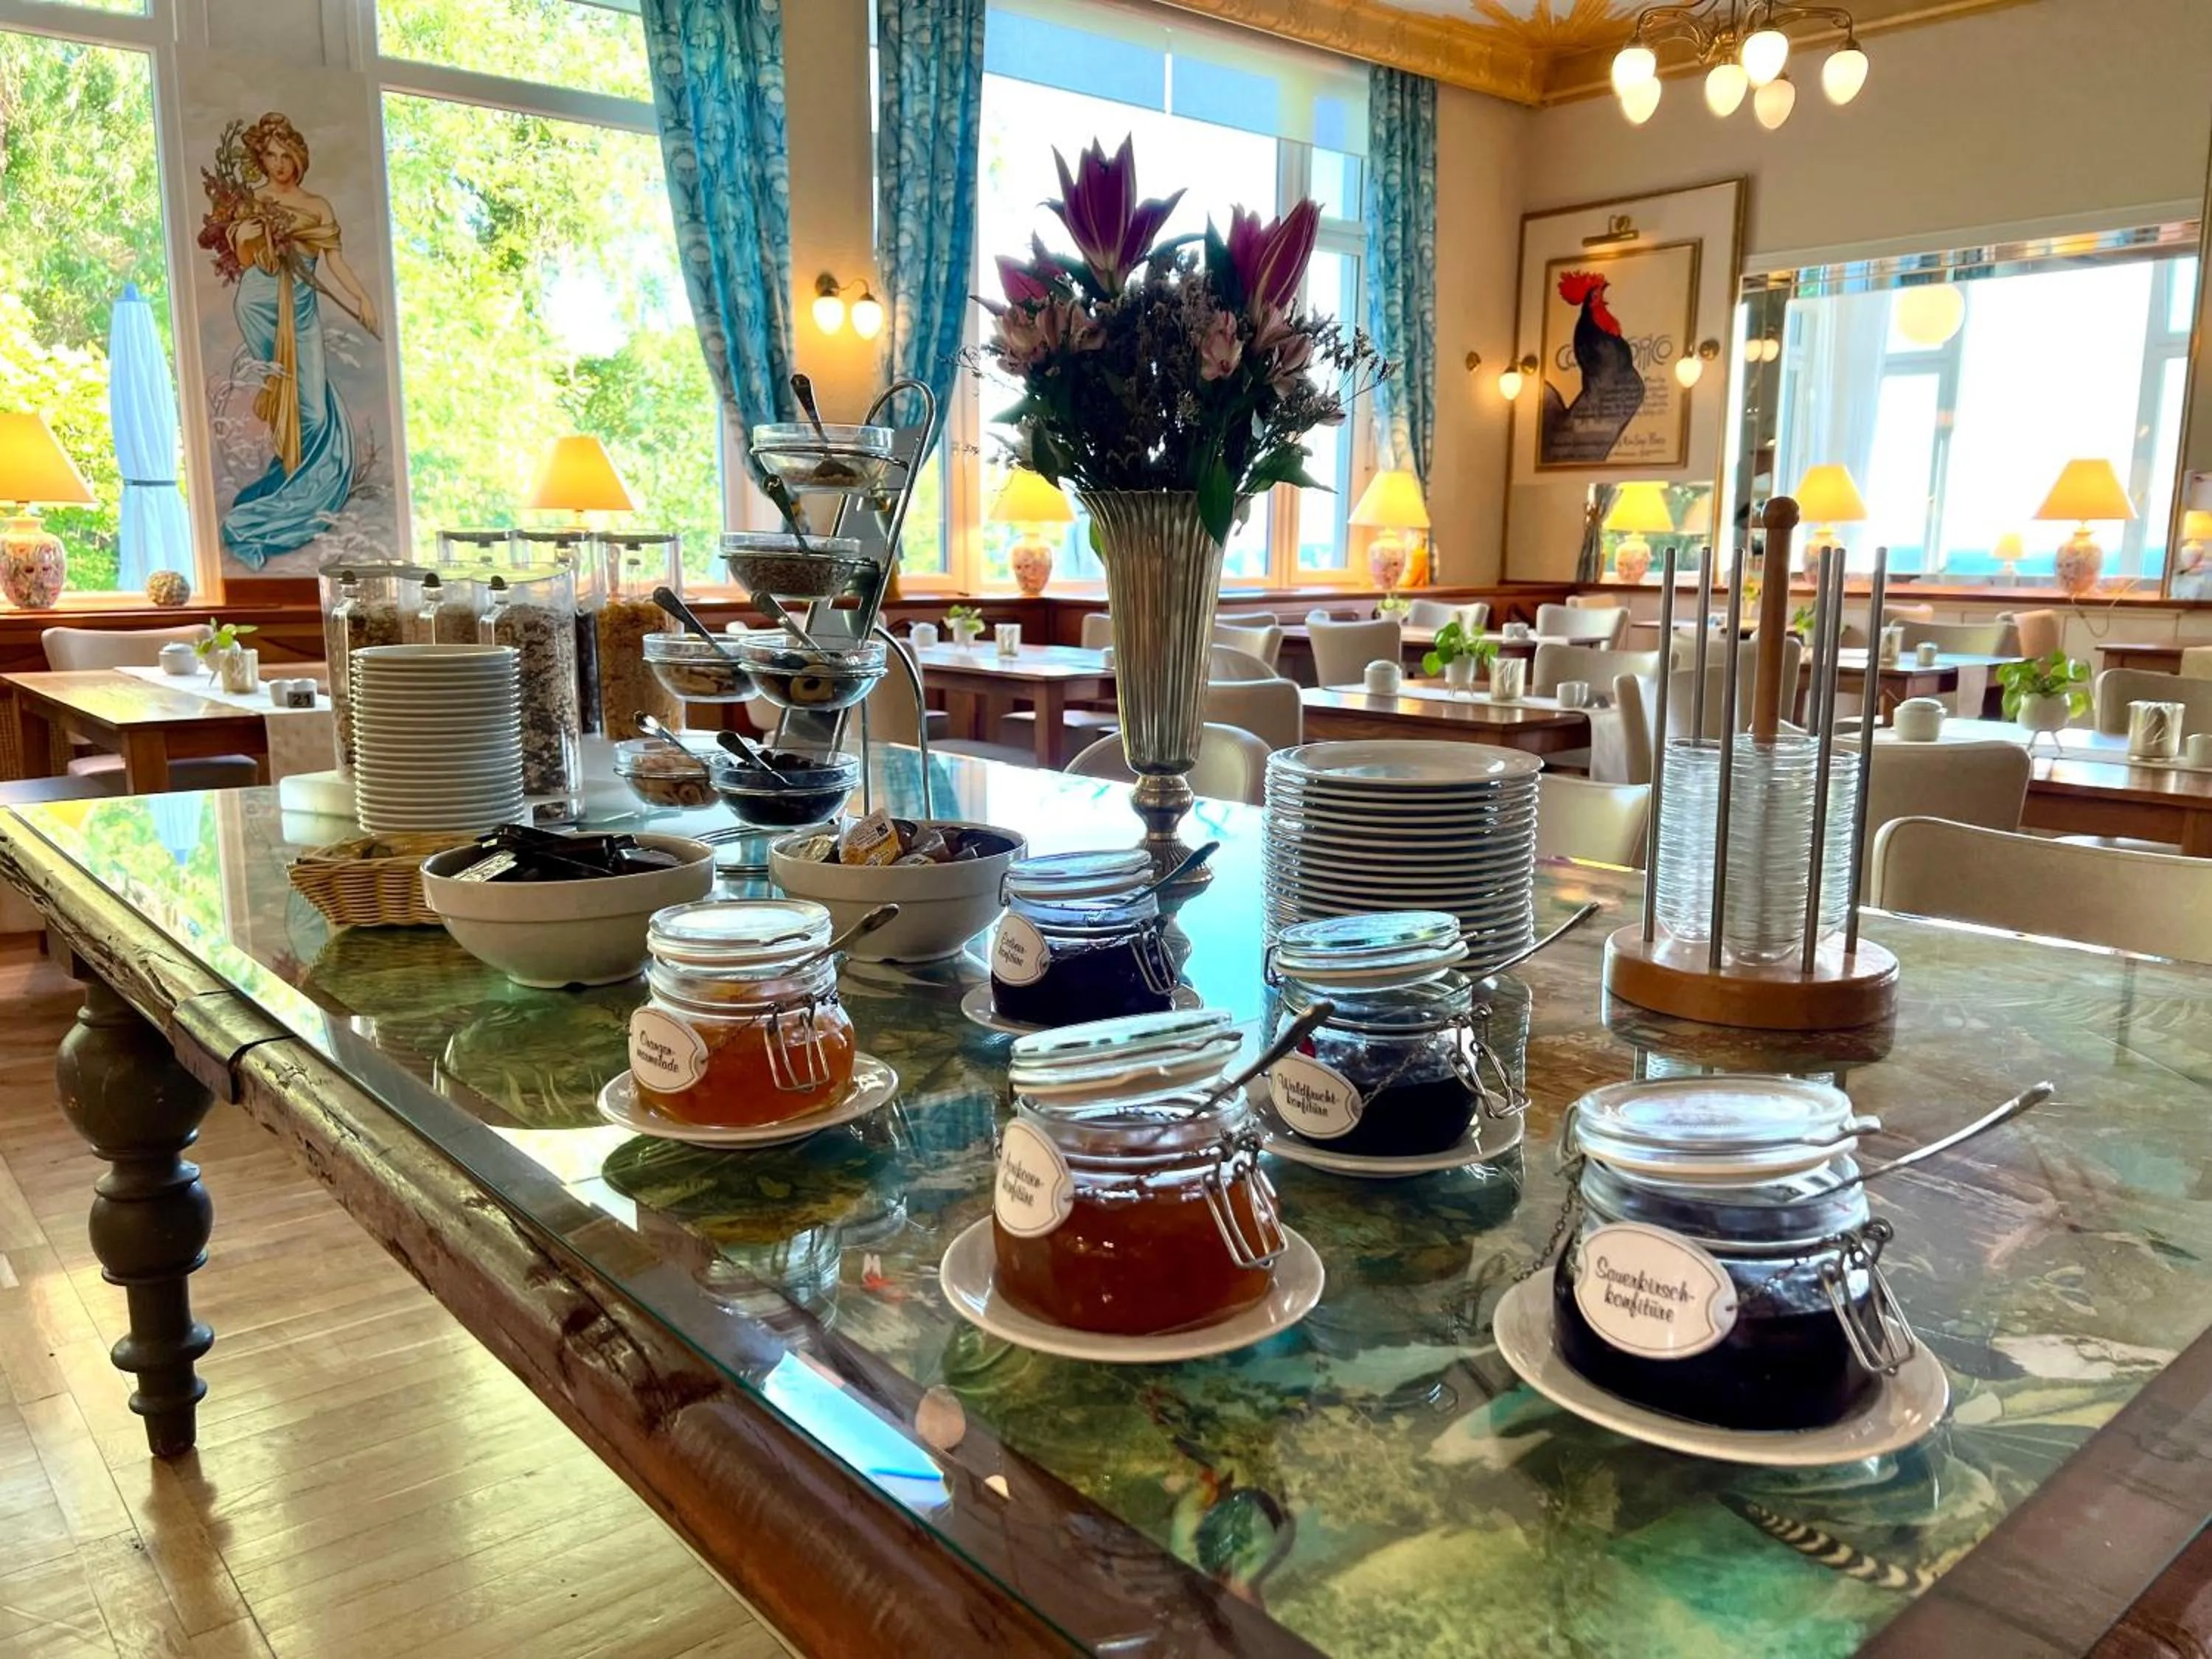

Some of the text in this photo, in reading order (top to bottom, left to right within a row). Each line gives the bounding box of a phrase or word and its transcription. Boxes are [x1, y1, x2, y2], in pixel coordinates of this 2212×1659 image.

[292, 693, 311, 706] 21
[639, 1029, 676, 1057] Orangen-
[1277, 1074, 1340, 1105] Waldfrucht-
[1286, 1090, 1329, 1117] konfitüre
[1595, 1255, 1696, 1303] Sauerkirsch-
[1604, 1282, 1675, 1324] konfitüre
